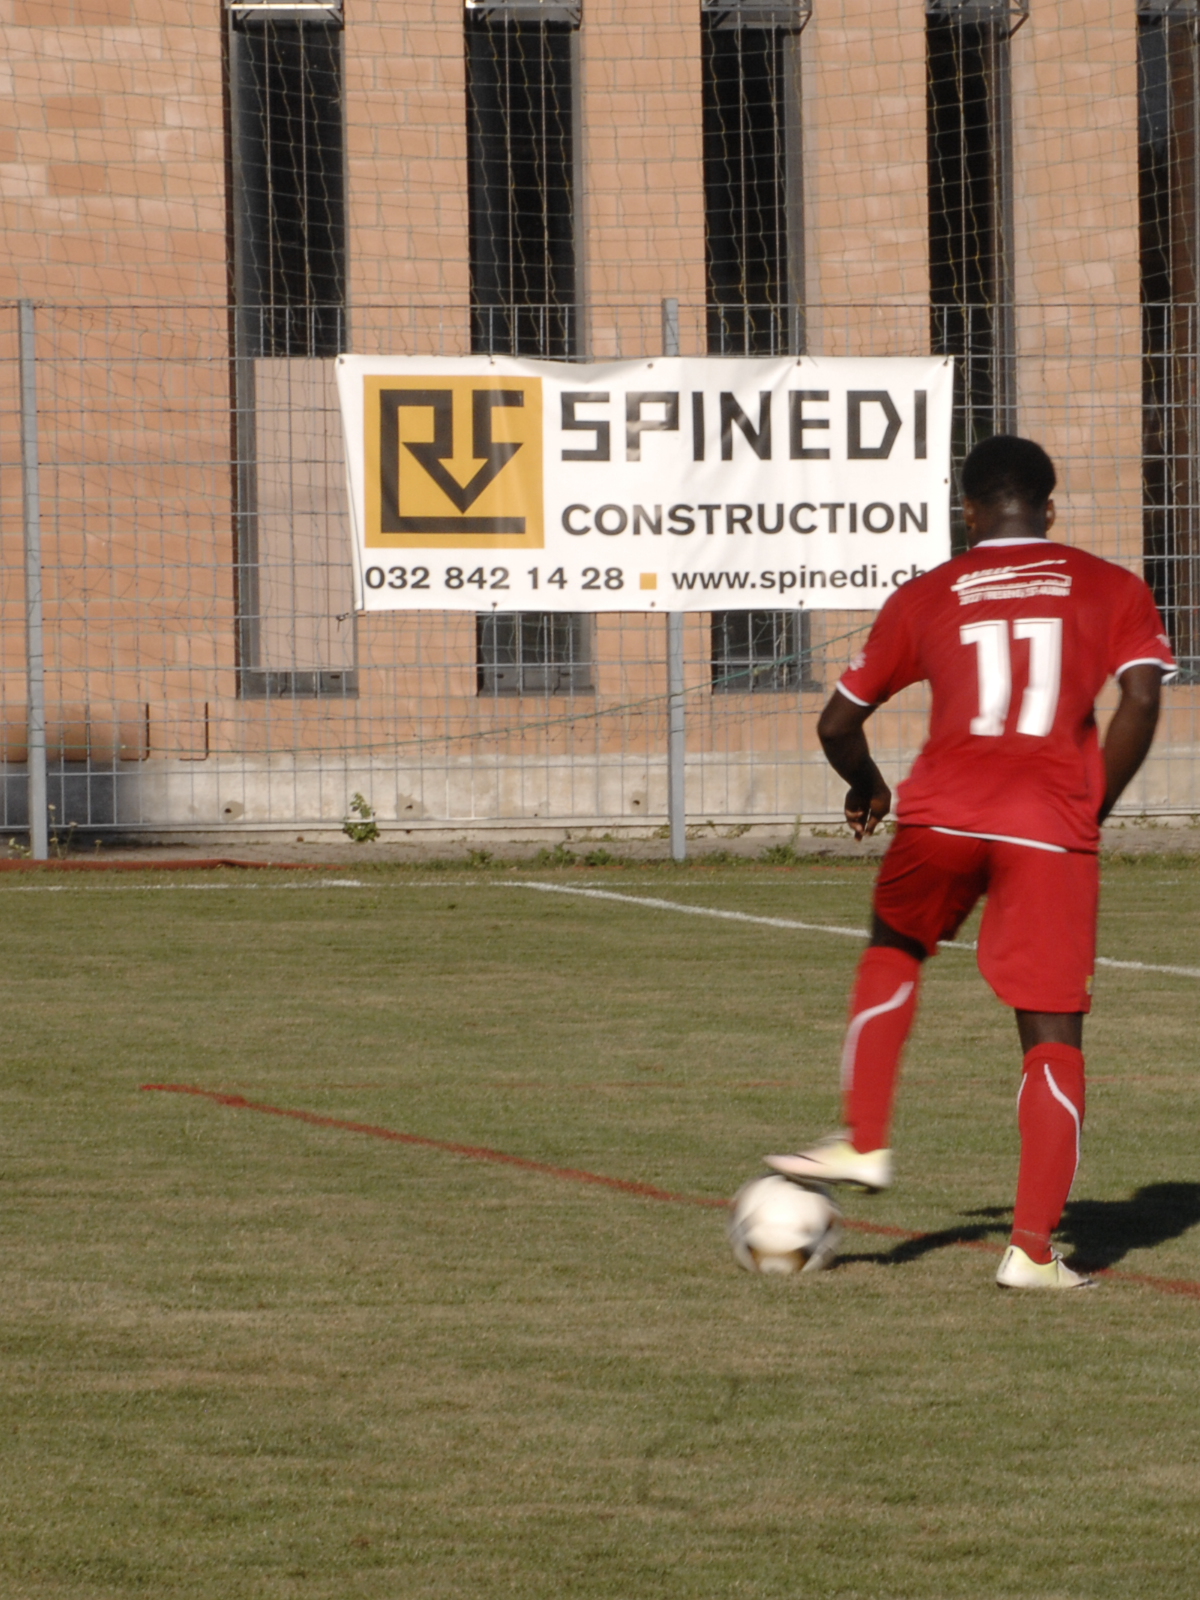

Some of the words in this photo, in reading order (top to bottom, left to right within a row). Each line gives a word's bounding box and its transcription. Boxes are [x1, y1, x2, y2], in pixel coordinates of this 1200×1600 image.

[560, 389, 928, 462] SPINEDI
[560, 502, 929, 536] CONSTRUCTION
[364, 566, 431, 590] 032
[444, 566, 511, 590] 842
[527, 566, 568, 590] 14
[581, 566, 625, 591] 28
[959, 617, 1063, 737] 11
